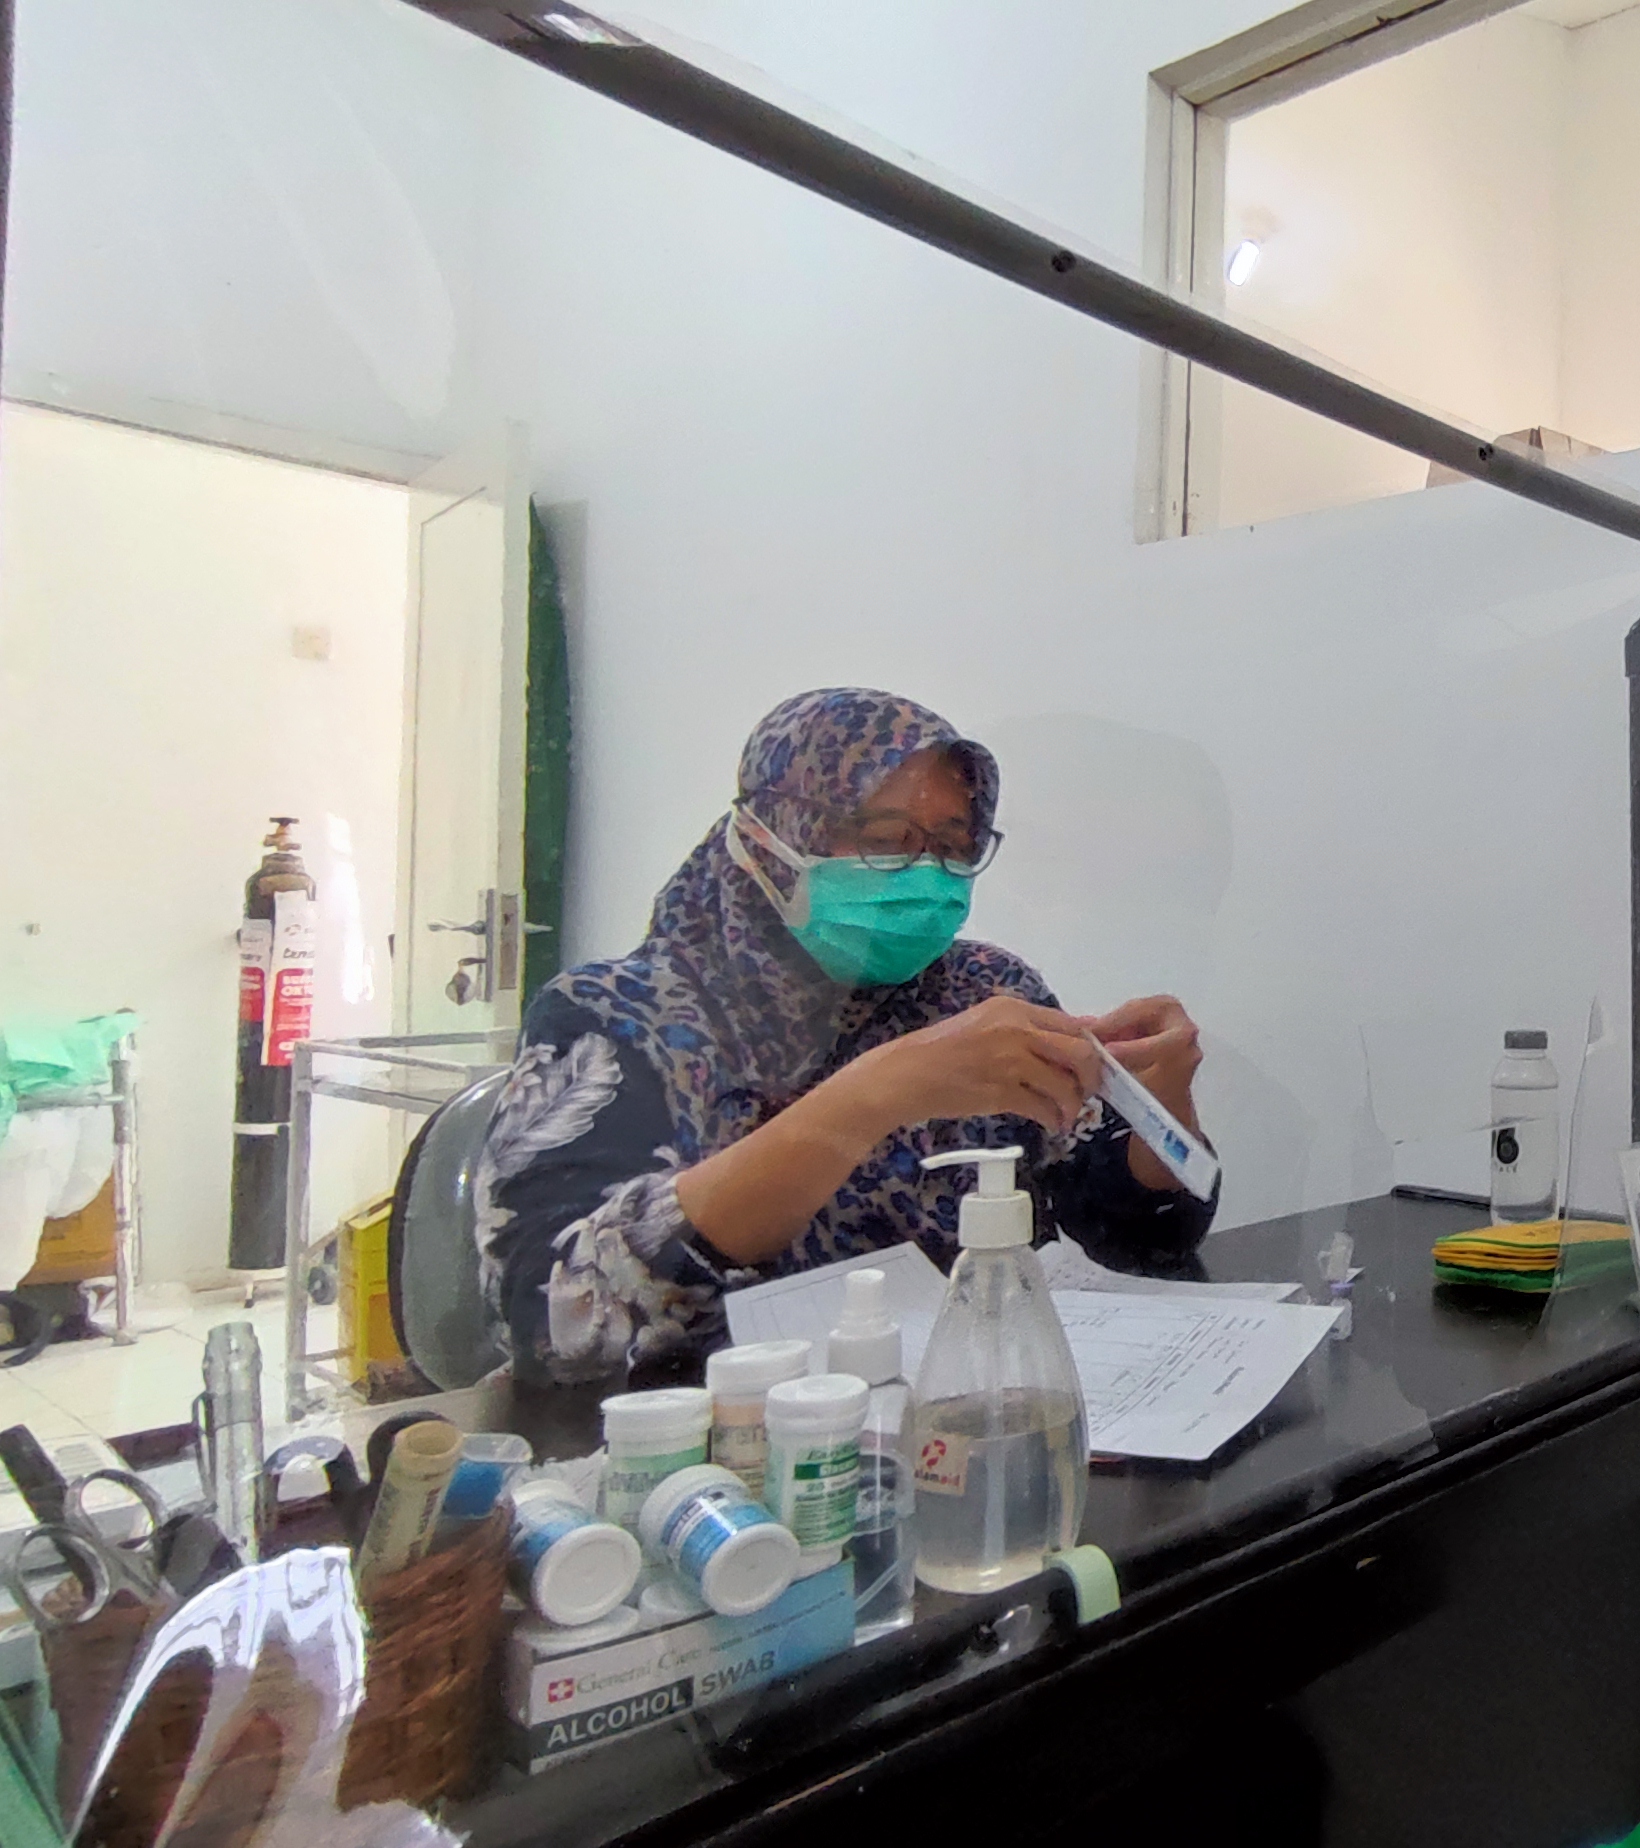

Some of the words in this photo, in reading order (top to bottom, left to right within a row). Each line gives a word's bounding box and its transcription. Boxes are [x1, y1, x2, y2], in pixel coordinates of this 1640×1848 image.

[546, 1686, 686, 1749] ALCOHOL
[700, 1649, 775, 1696] SWAB
[575, 1659, 652, 1695] General
[657, 1648, 701, 1671] Care
